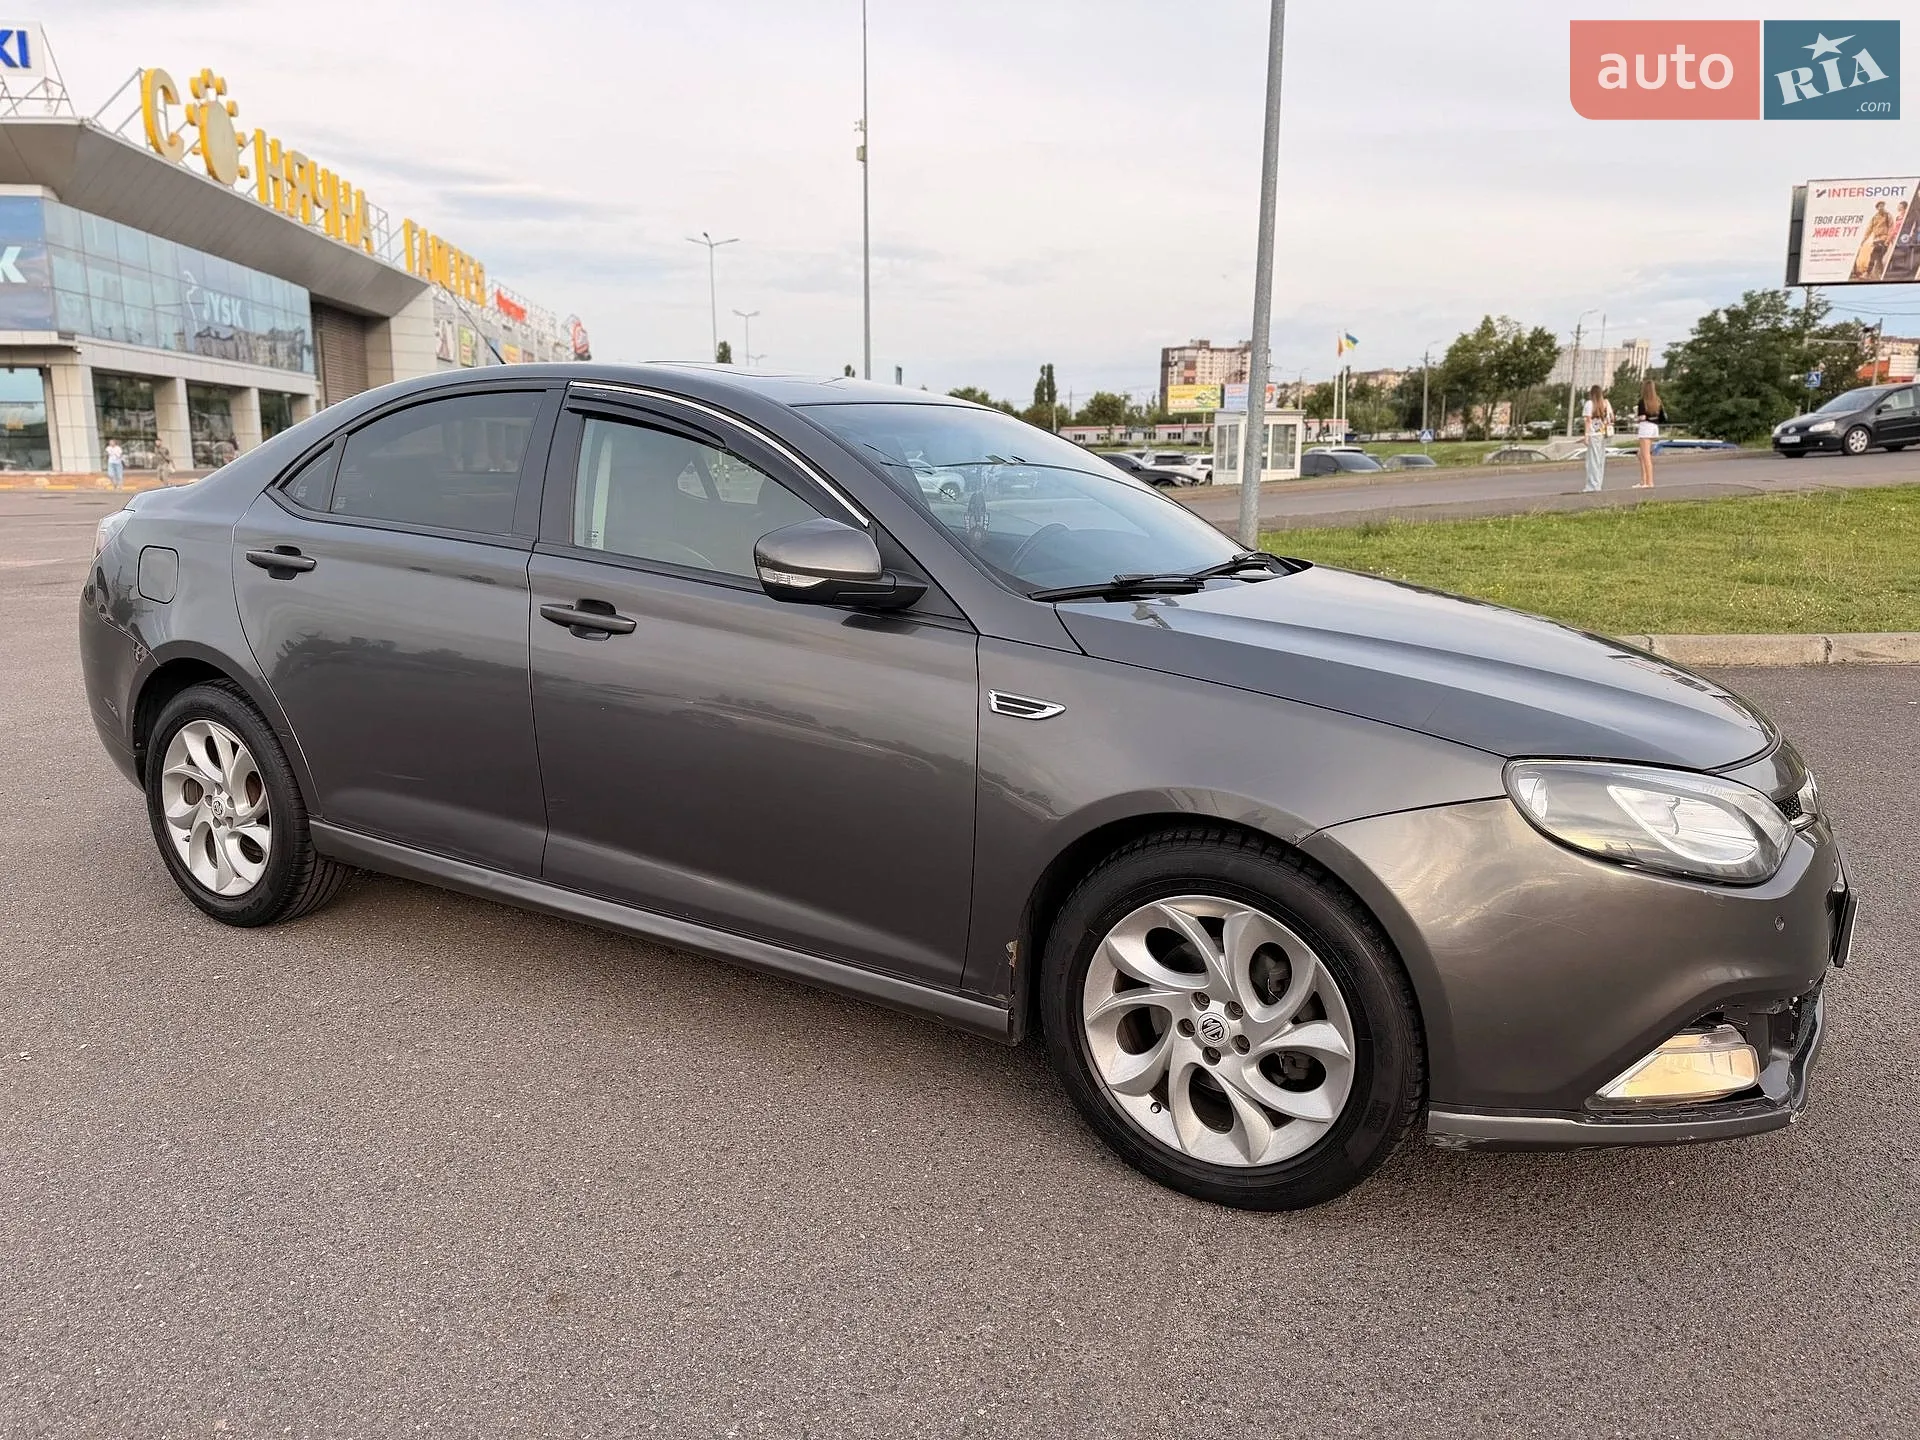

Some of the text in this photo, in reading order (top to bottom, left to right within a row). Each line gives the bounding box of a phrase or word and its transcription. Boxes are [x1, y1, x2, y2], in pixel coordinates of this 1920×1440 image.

[1827, 186, 1907, 198] INTERSPORT
[1813, 214, 1864, 225] ТВОЯ ЕНЕРГІЯ
[1812, 226, 1859, 238] ЖИВЕ ТУТ
